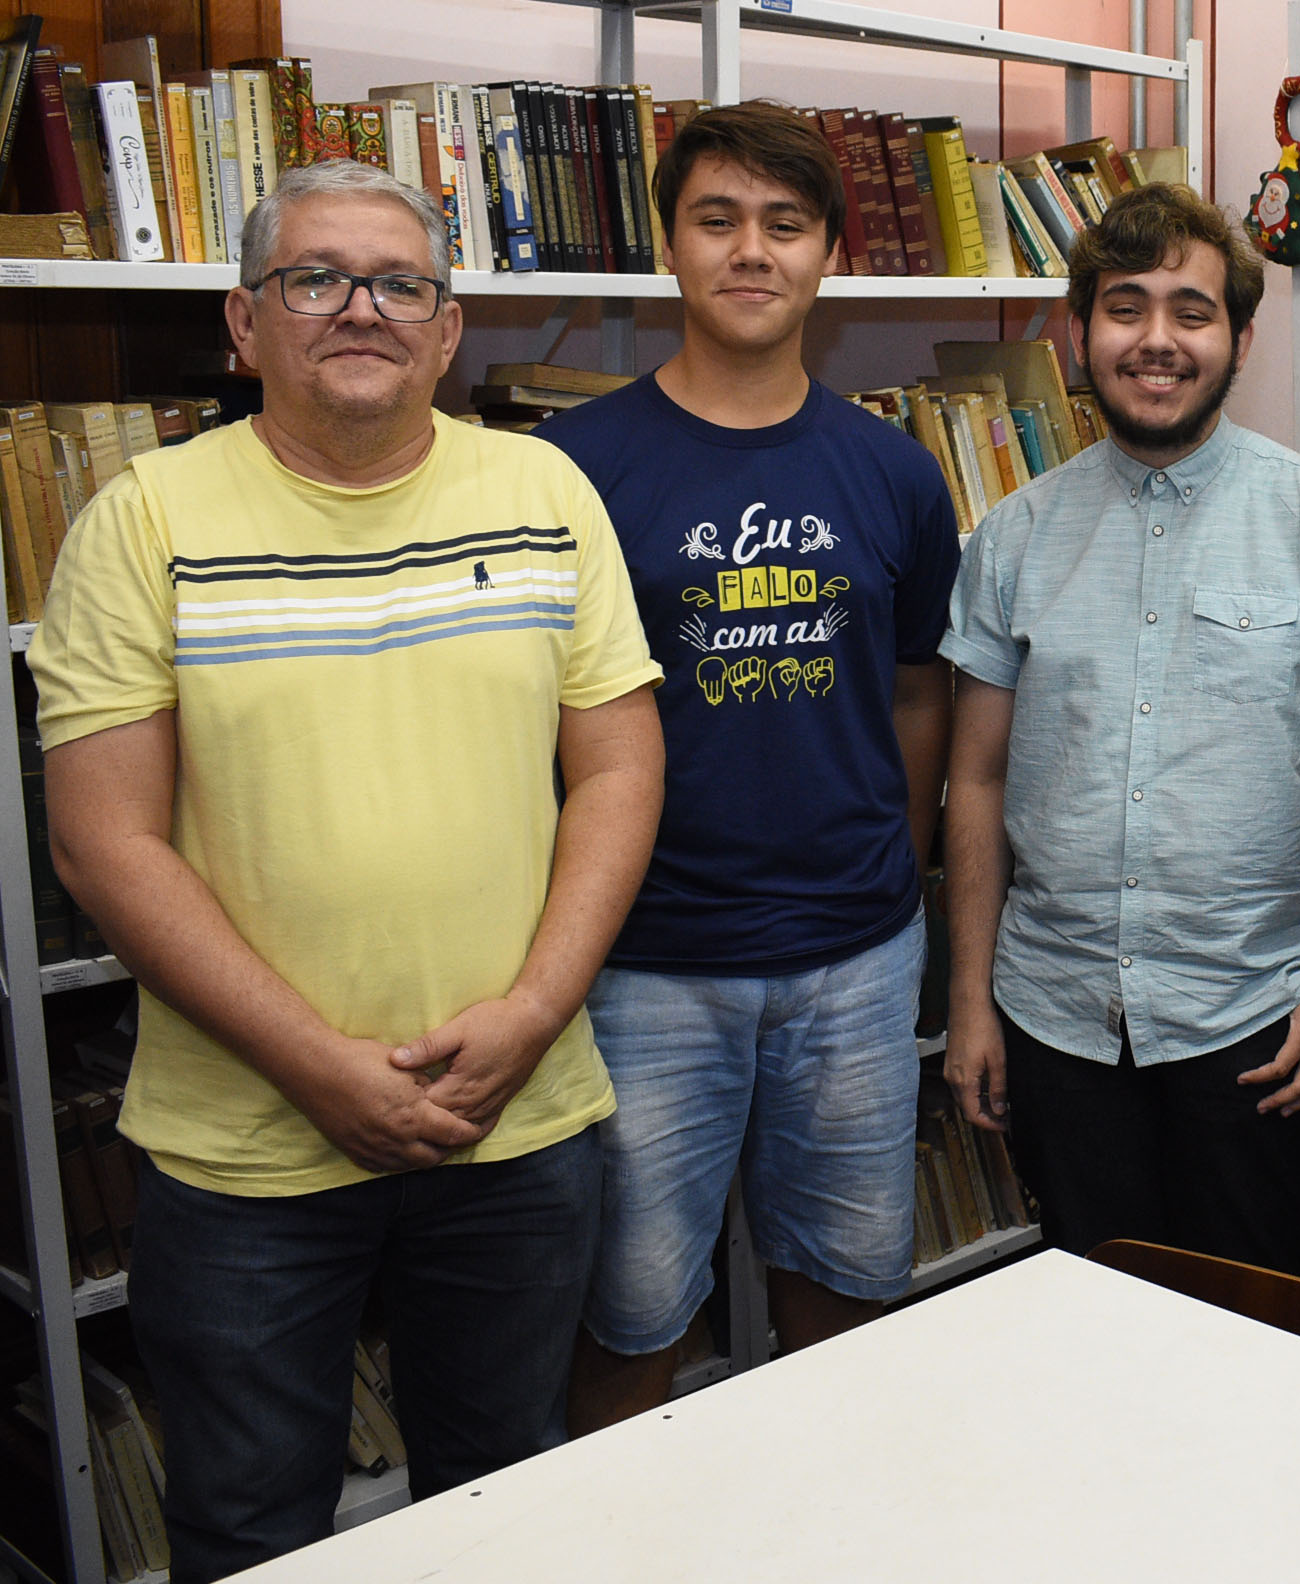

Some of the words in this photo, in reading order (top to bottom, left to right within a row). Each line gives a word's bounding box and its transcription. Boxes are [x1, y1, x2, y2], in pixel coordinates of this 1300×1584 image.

[249, 99, 256, 107] de
[451, 92, 460, 123] HERMANN
[474, 96, 483, 129] HERMANN
[480, 94, 490, 121] ERMANN
[549, 104, 557, 122] VEGA
[522, 110, 530, 138] VICENTE
[551, 123, 558, 133] DE
[627, 109, 635, 130] HUGO
[454, 126, 463, 146] HESSE
[484, 123, 493, 146] HESSE
[537, 125, 545, 147] TASSO
[593, 124, 601, 153] SCHILLER
[615, 128, 624, 152] BALZAC
[630, 131, 638, 154] VICTOR
[205, 140, 214, 174] outros
[254, 142, 262, 155] jogo
[208, 177, 215, 189] os
[253, 163, 265, 197] HESSE
[457, 162, 466, 194] Debaixo
[487, 151, 500, 204] GERTRUD
[484, 183, 493, 208] KNULP
[229, 204, 240, 215] OS
[210, 200, 221, 248] xerazade
[732, 502, 792, 565] Eu
[720, 571, 814, 606] FALO
[711, 624, 777, 650] com
[785, 618, 828, 645] as
